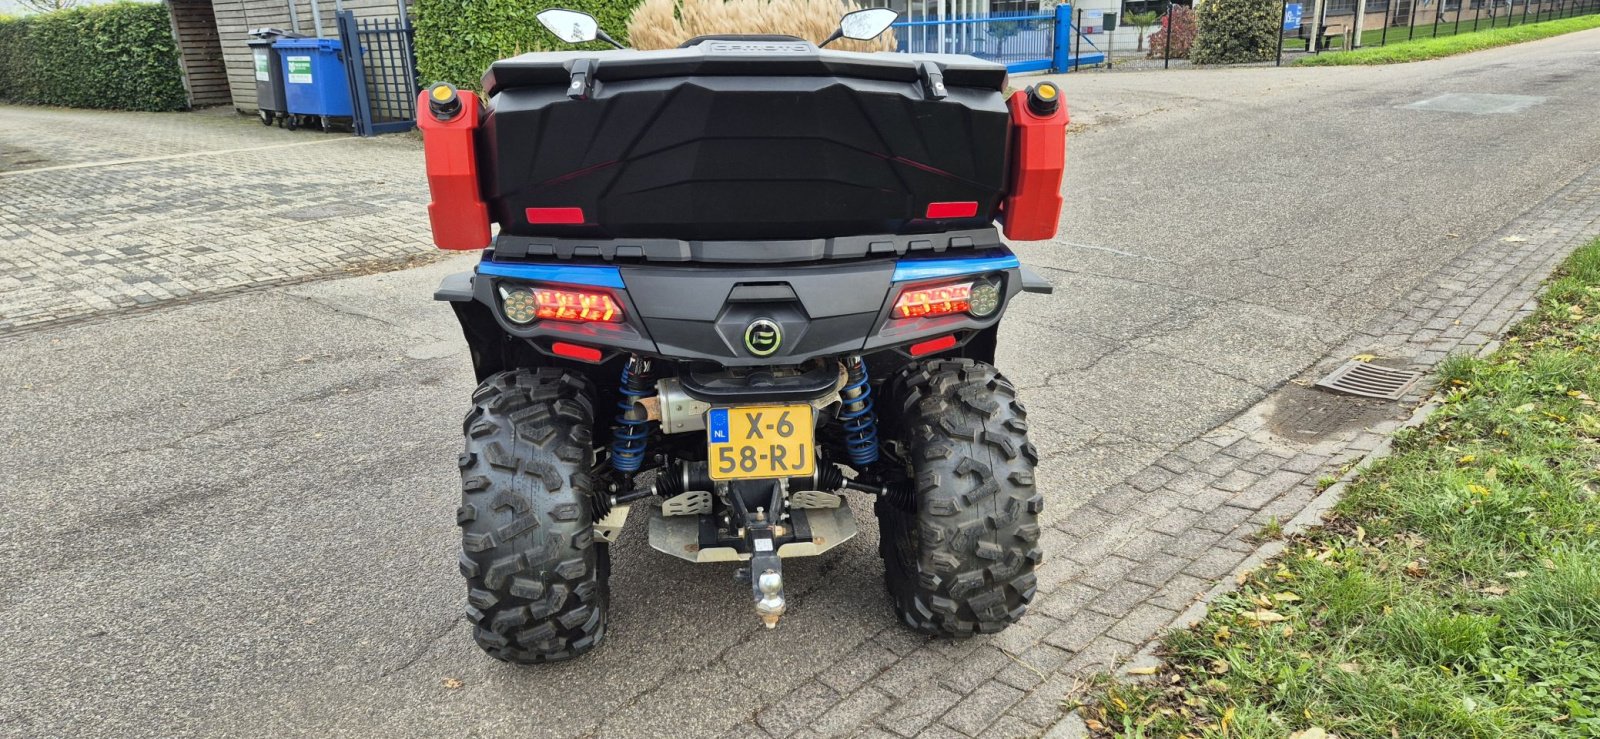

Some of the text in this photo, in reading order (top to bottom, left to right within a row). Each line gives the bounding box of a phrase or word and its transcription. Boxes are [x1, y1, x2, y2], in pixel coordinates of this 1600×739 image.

[714, 430, 726, 438] NL
[745, 411, 794, 439] X-6
[718, 443, 805, 474] 58-RJ
